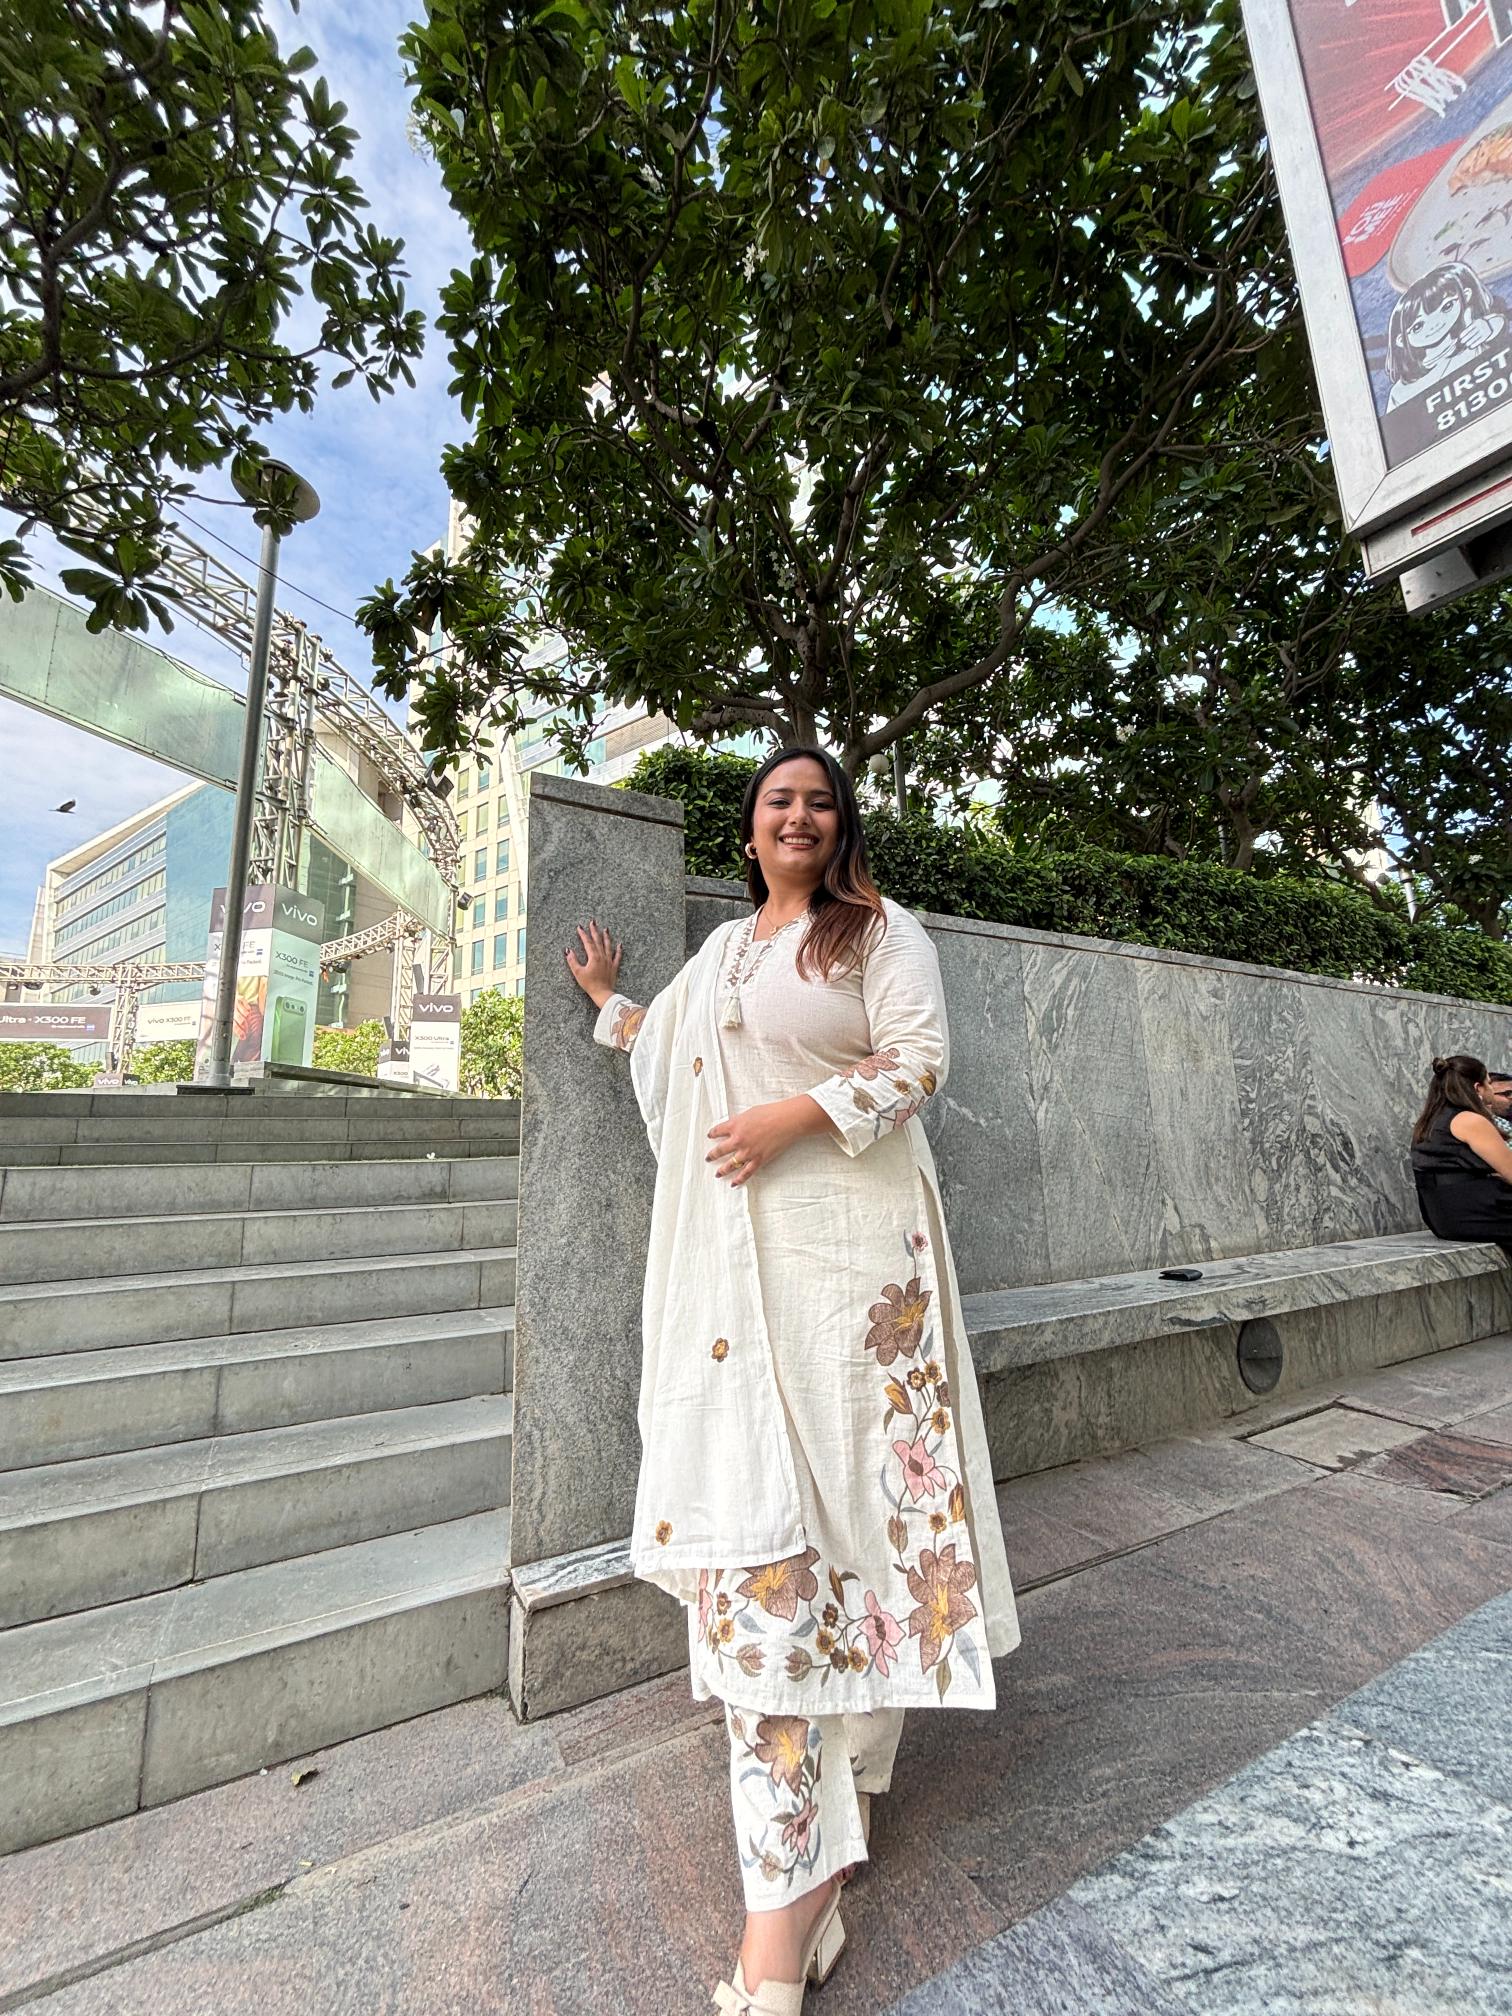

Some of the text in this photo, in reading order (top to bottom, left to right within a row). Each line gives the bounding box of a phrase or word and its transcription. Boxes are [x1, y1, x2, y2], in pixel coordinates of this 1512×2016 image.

[1425, 347, 1511, 414] FIRST
[1437, 371, 1512, 431] 8130
[281, 903, 318, 926] vivo
[275, 951, 298, 965] X300
[419, 1002, 454, 1014] vivo
[34, 1015, 69, 1025] X300
[70, 1015, 87, 1025] FE
[147, 1017, 165, 1025] vivo
[97, 1077, 120, 1085] vivo
